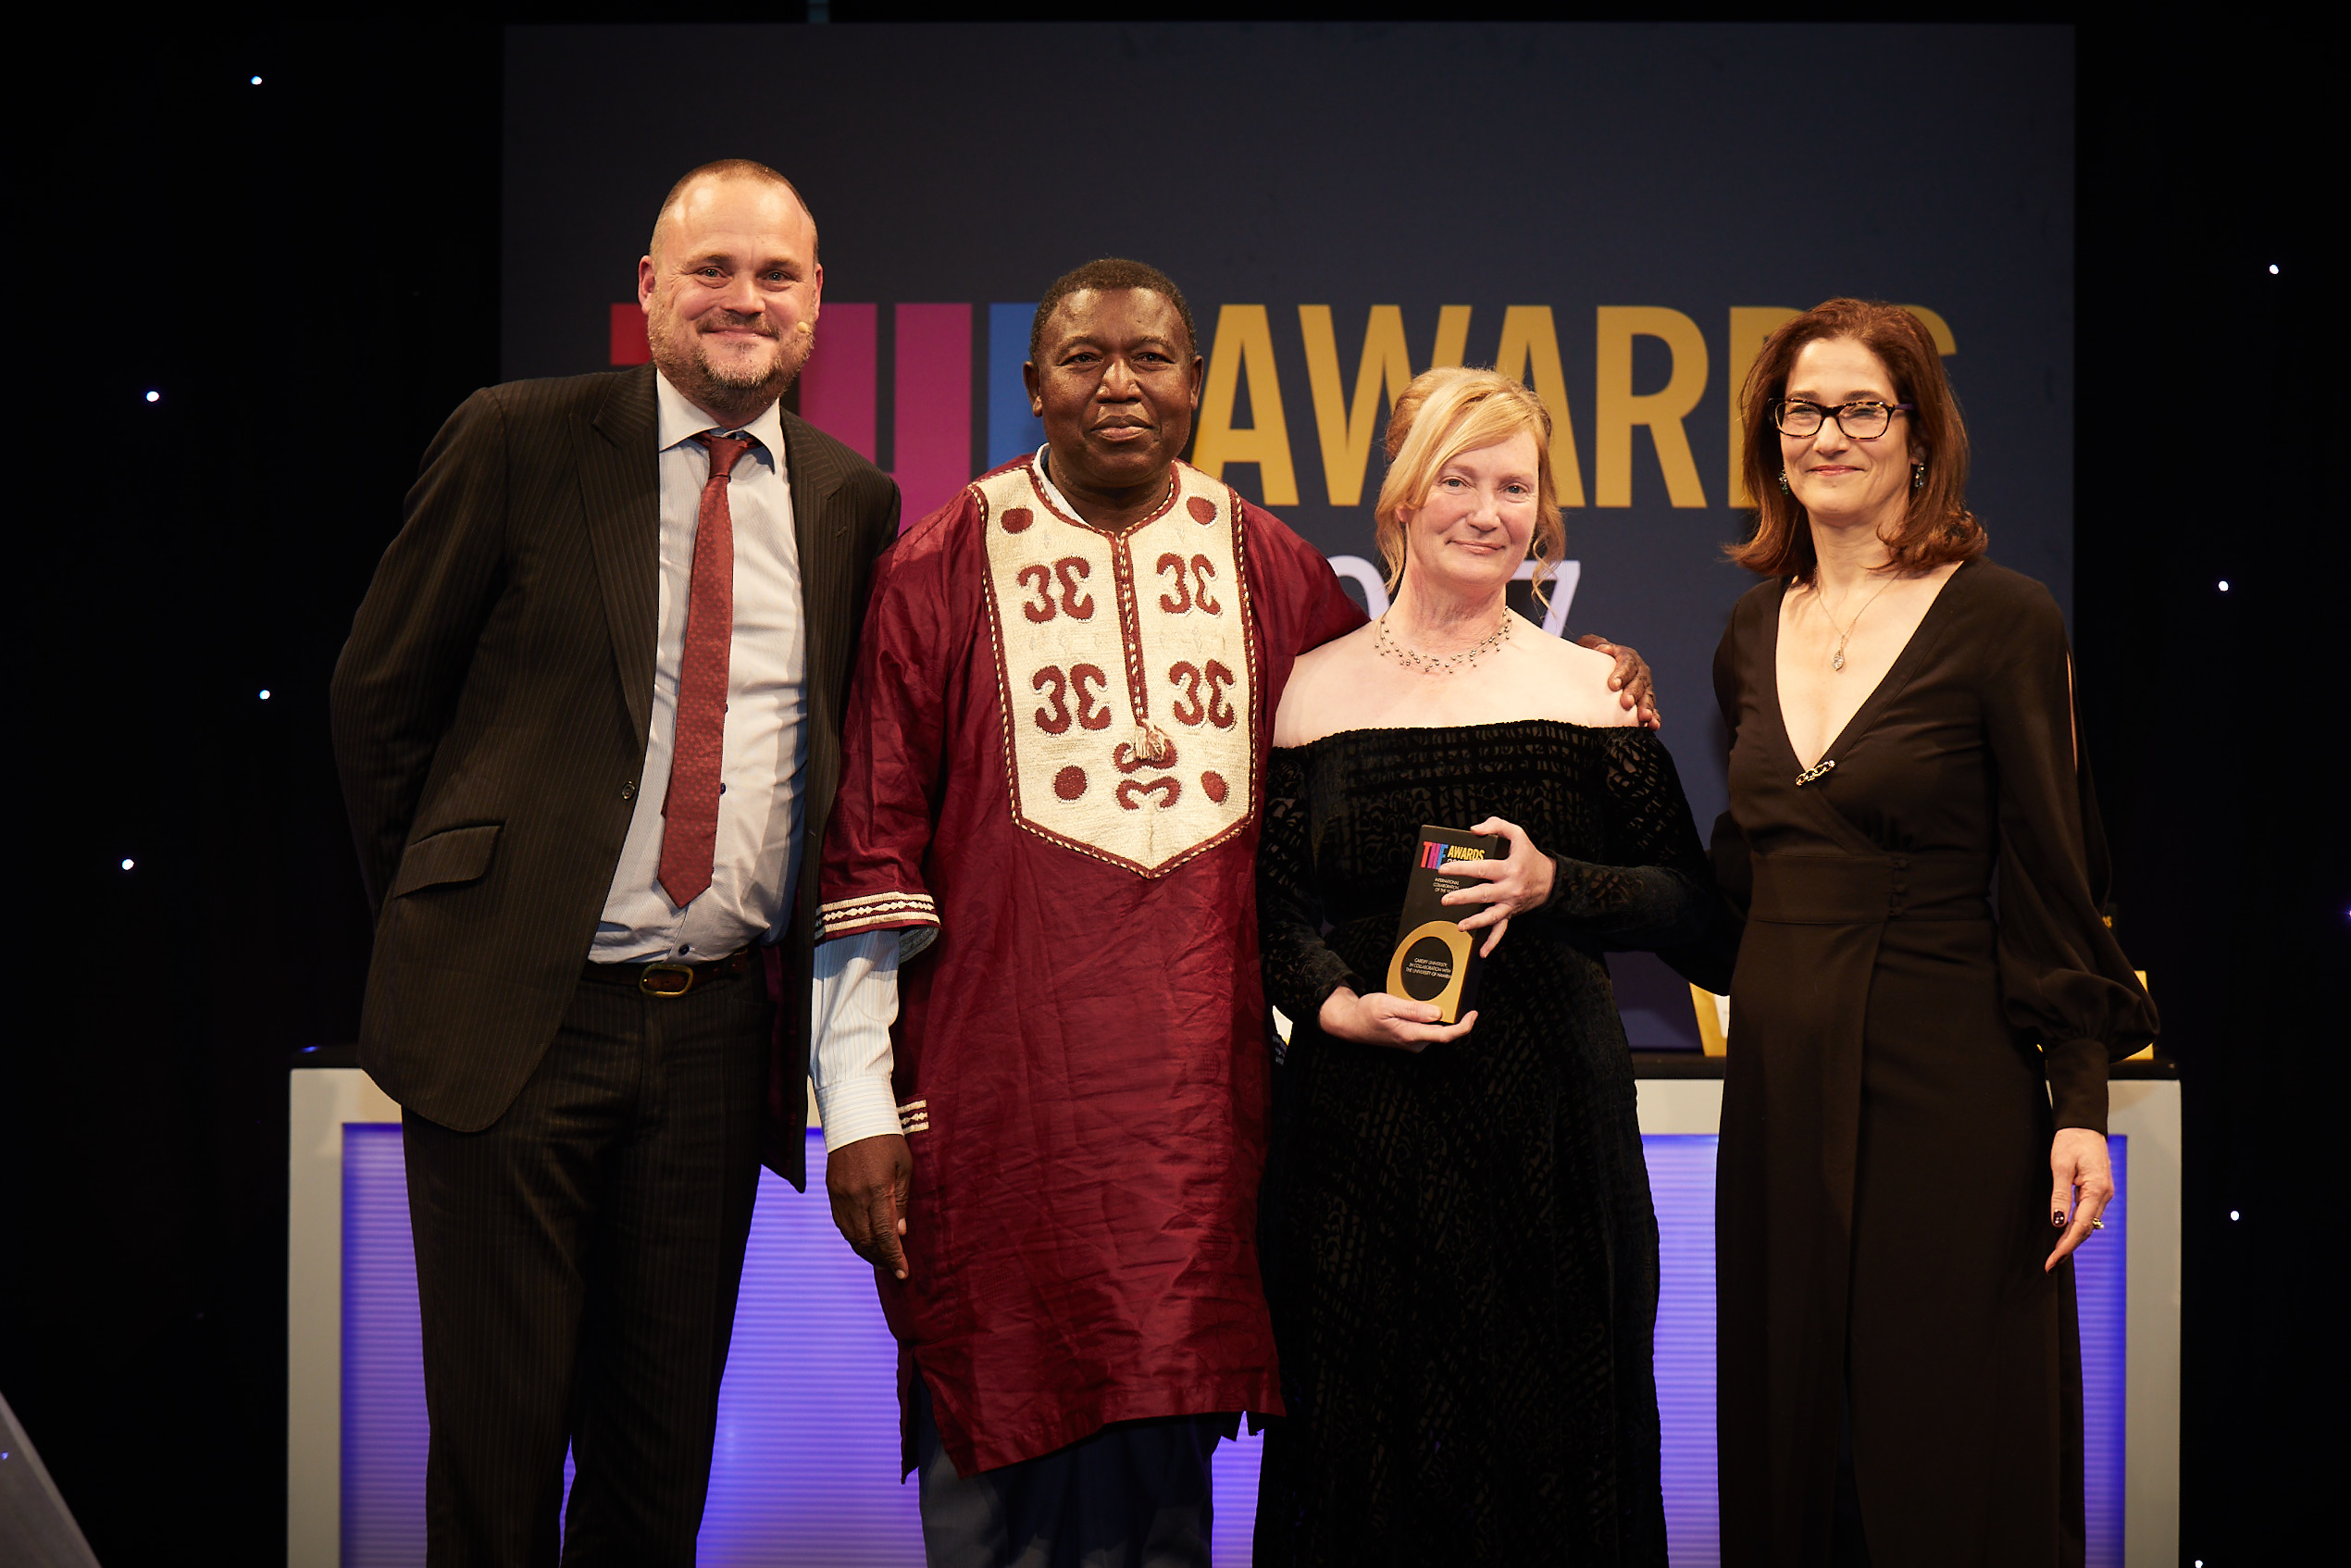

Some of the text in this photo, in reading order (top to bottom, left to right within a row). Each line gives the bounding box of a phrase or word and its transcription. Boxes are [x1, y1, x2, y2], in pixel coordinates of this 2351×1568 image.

[1188, 304, 1957, 509] AWAR
[1420, 840, 1486, 870] THE AWARDS
